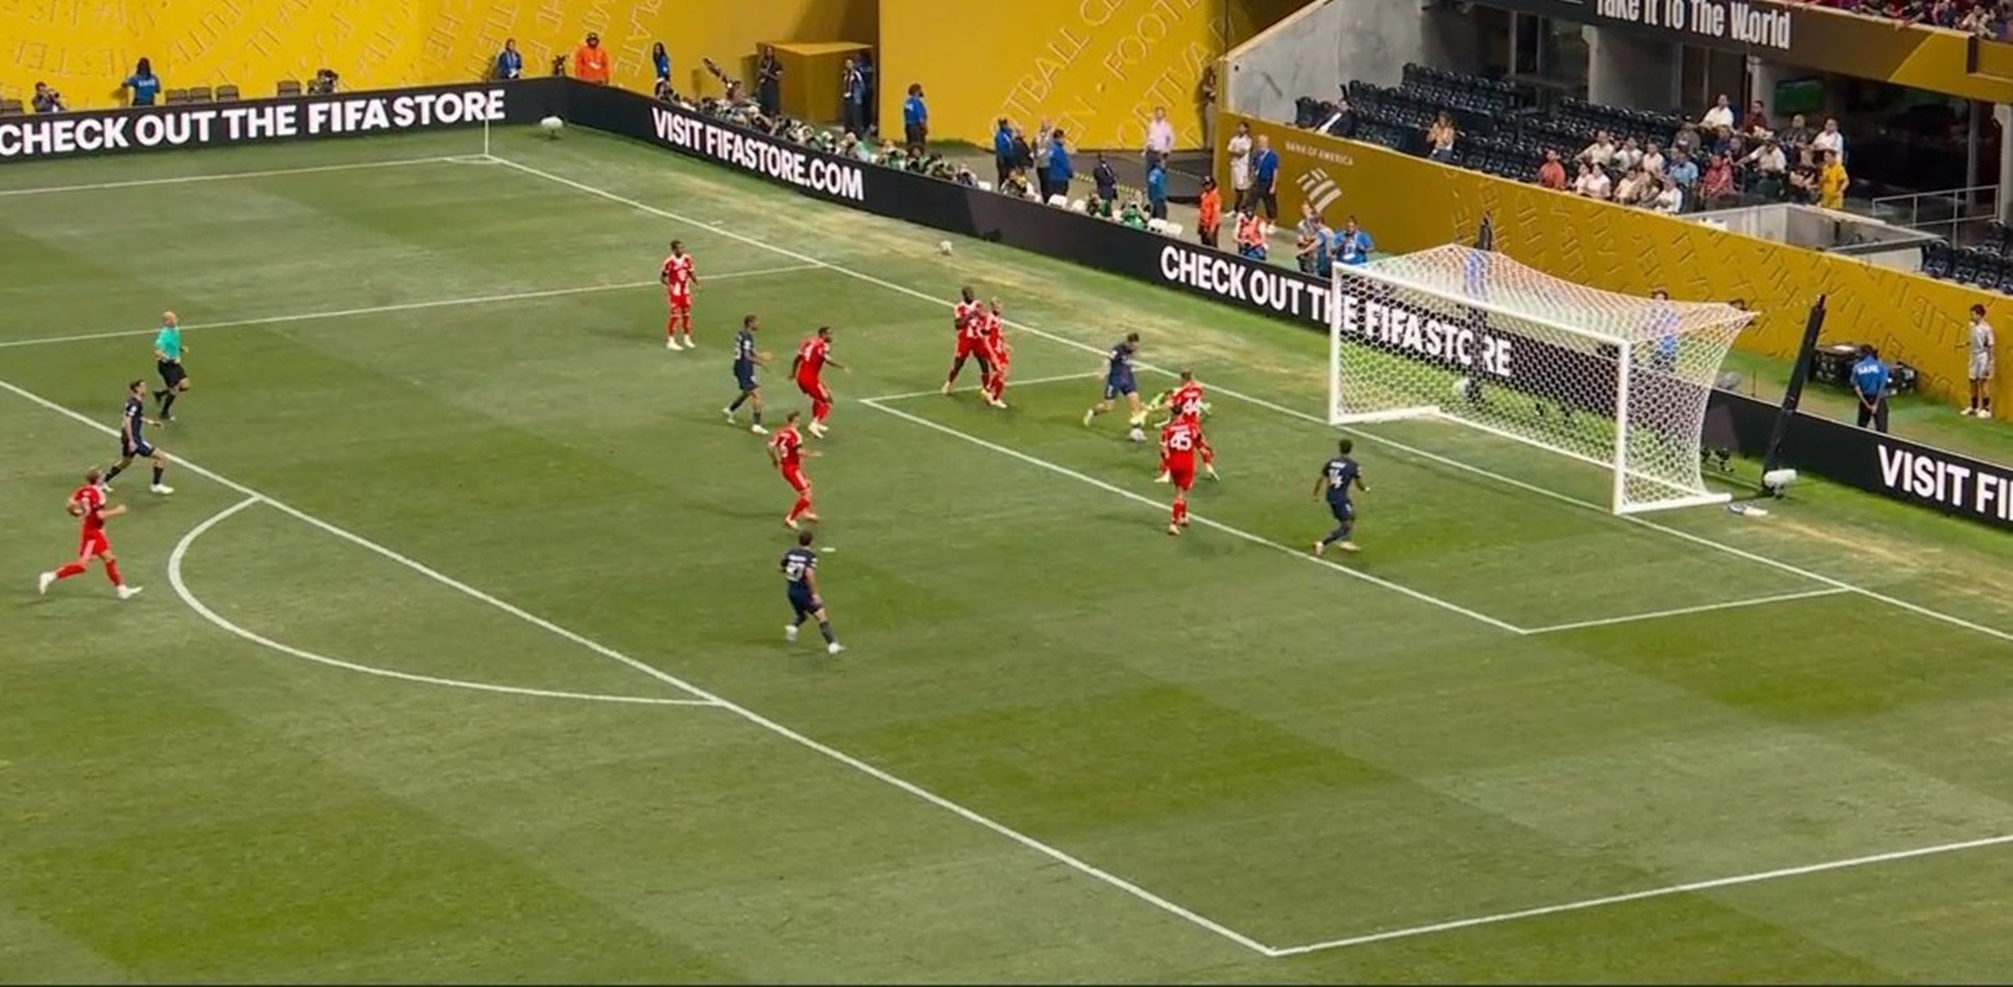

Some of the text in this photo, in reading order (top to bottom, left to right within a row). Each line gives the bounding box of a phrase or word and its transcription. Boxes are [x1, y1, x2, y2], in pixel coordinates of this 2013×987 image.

[1691, 0, 1724, 37] The
[1730, 2, 1791, 49] World
[0, 89, 506, 156] CHECK OUT THE FIFA STORE
[652, 107, 864, 201] VISIT FIFASTORE.COM
[1160, 246, 1249, 300] CHECK
[1250, 271, 1304, 315] OUT
[1170, 430, 1193, 451] 45
[1878, 444, 1971, 507] VISIT
